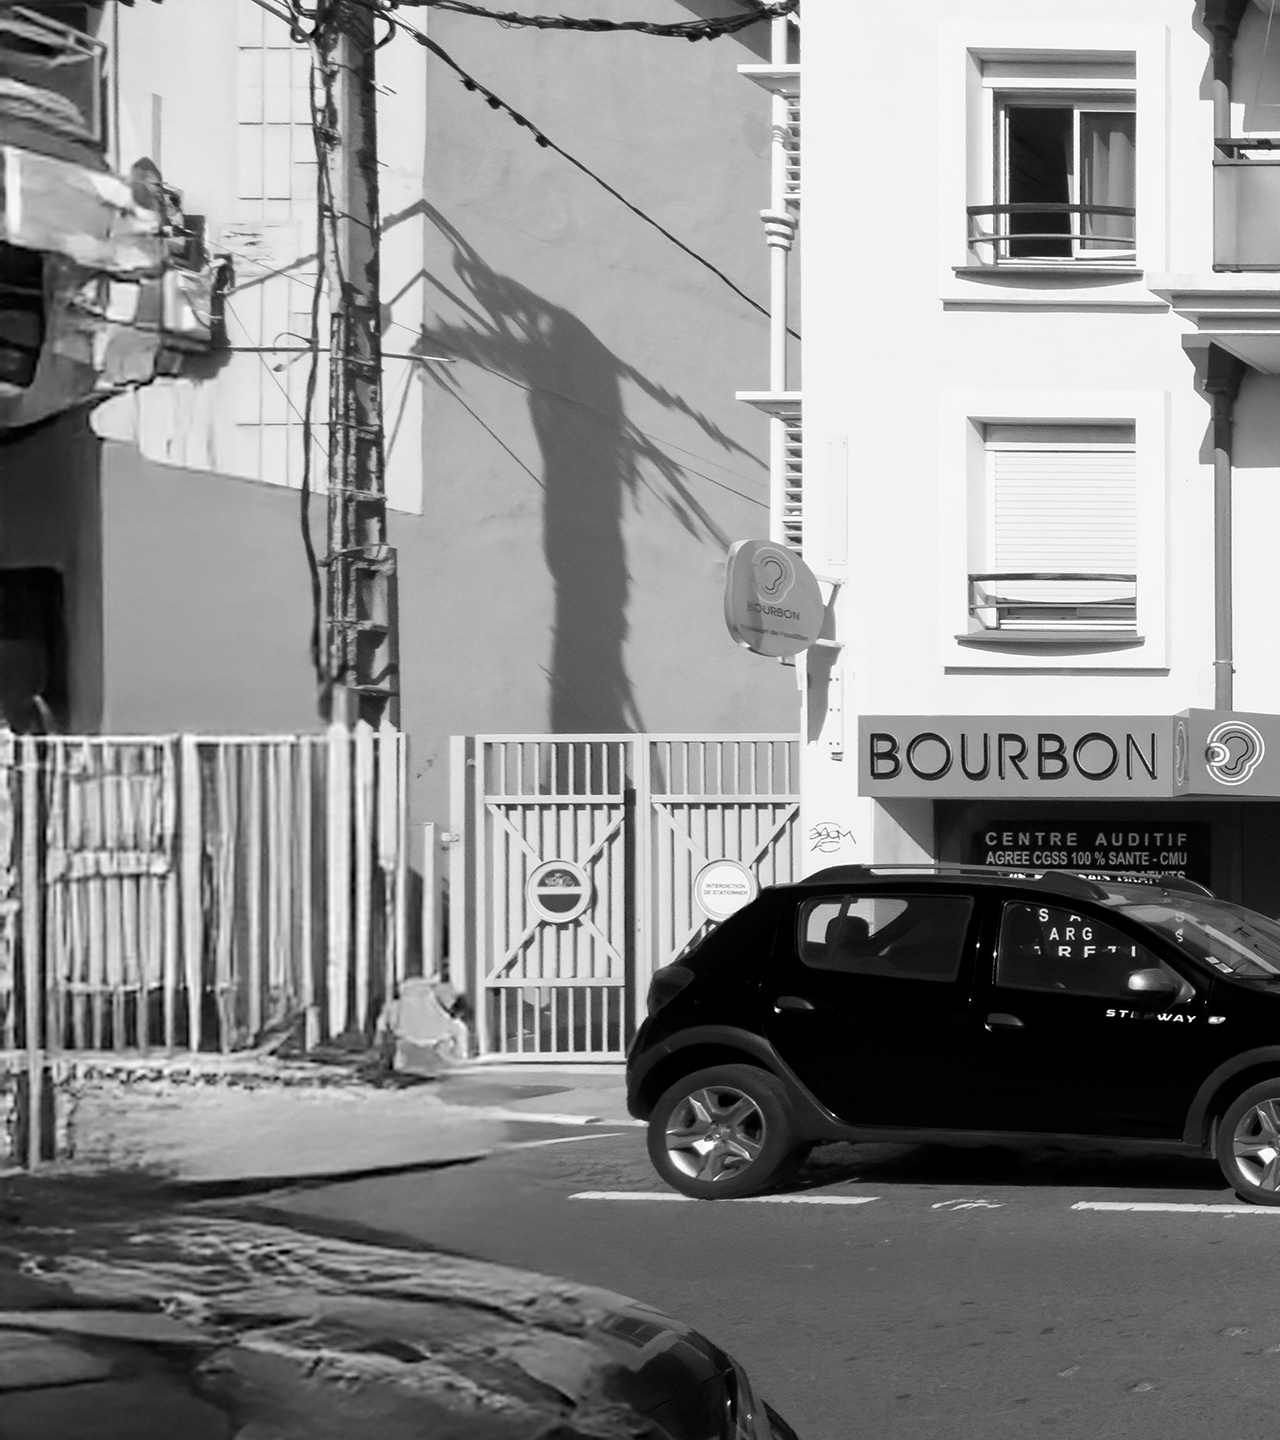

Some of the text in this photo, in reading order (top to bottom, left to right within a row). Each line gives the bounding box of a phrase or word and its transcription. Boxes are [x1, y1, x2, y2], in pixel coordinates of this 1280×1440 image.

[747, 602, 800, 620] BOURBON
[870, 732, 1158, 781] BOURBON
[985, 832, 1187, 846] CENTRE AUDITIF
[986, 851, 1030, 865] AGREE
[1033, 851, 1067, 865] CGSS
[1071, 852, 1091, 865] 100
[1094, 852, 1106, 865] %
[1108, 852, 1149, 865] SANTE
[1160, 852, 1188, 865] CMU
